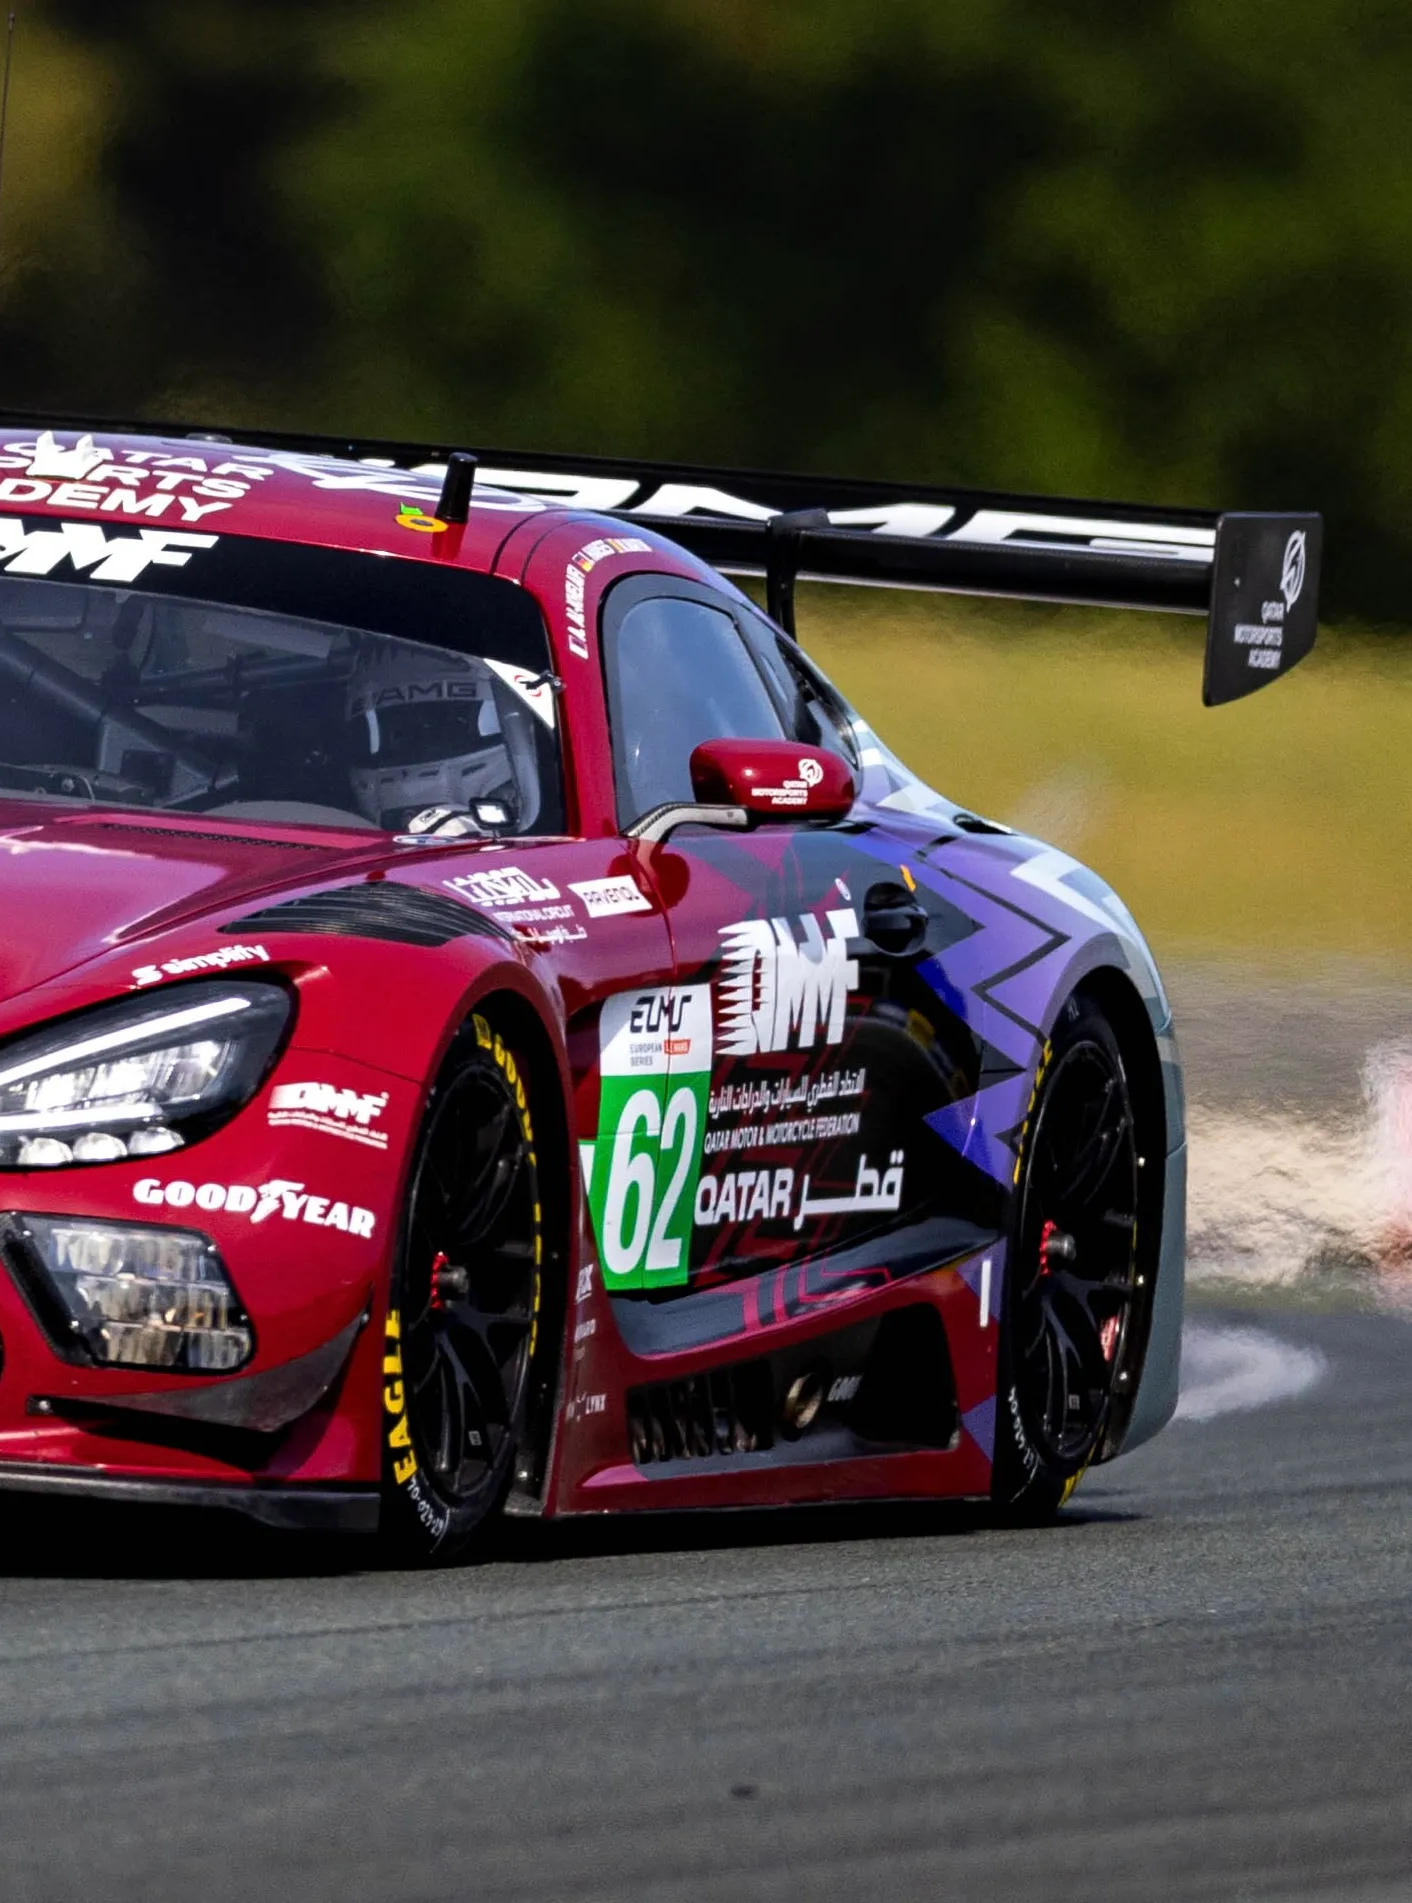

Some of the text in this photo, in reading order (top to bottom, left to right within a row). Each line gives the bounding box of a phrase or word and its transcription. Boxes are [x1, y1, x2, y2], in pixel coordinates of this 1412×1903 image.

[376, 681, 477, 703] AMG
[630, 1042, 662, 1054] EUROPEAN
[704, 1129, 730, 1155] QATAR
[730, 1126, 758, 1150] MOTOR
[765, 1118, 815, 1144] MOTORCYCLE
[815, 1112, 861, 1140] FEDERATION
[133, 1178, 376, 1239] GOODYEAR
[602, 1086, 698, 1275] 62
[694, 1150, 905, 1231] QATAR قطر
[383, 1309, 419, 1485] EAGLE
